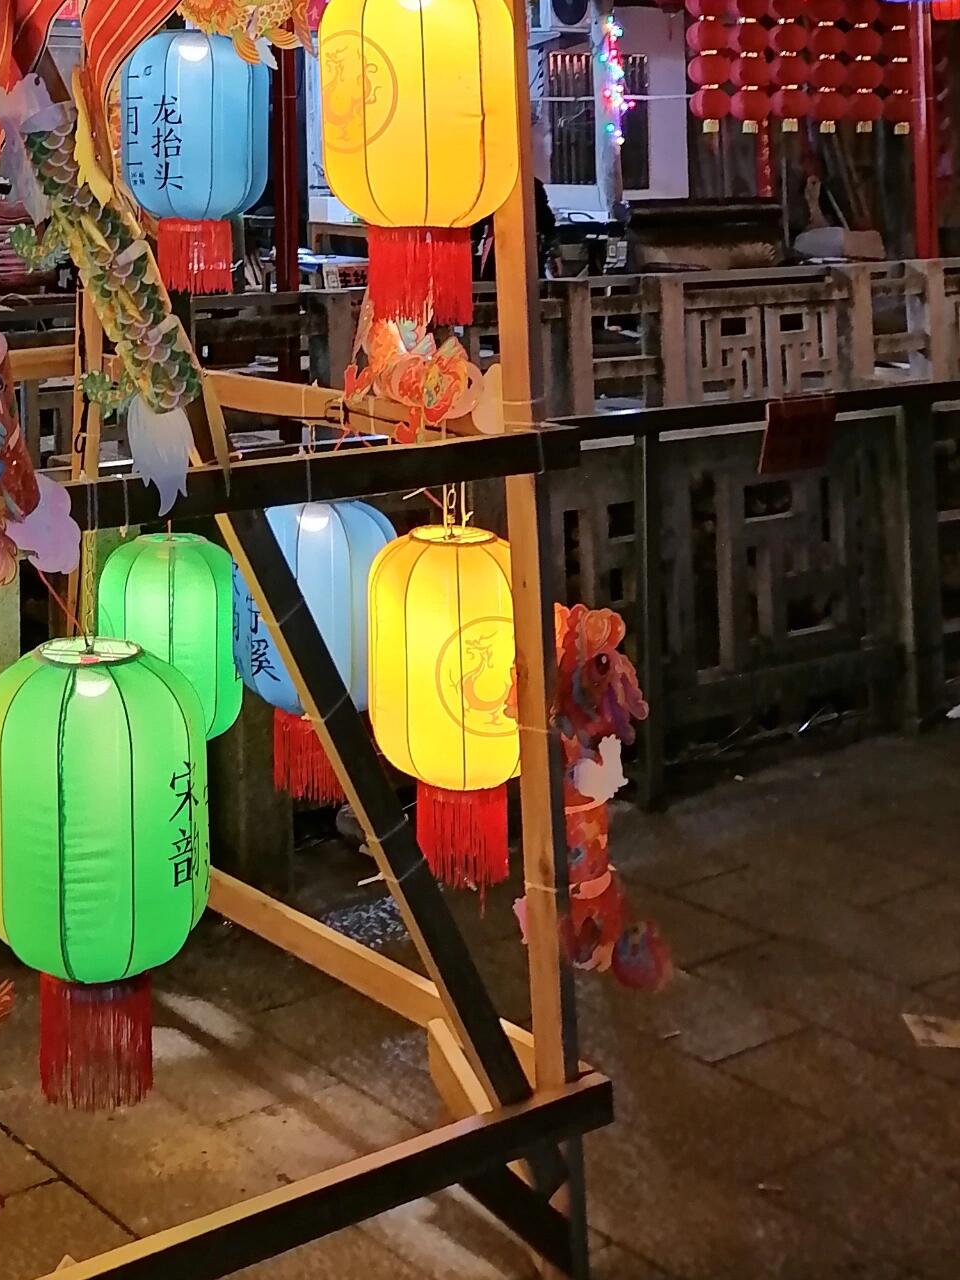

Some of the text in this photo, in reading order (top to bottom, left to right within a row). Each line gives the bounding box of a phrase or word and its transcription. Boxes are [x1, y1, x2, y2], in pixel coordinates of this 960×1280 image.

[151, 94, 184, 190] 龙抬头
[168, 760, 201, 888] 宋韵
